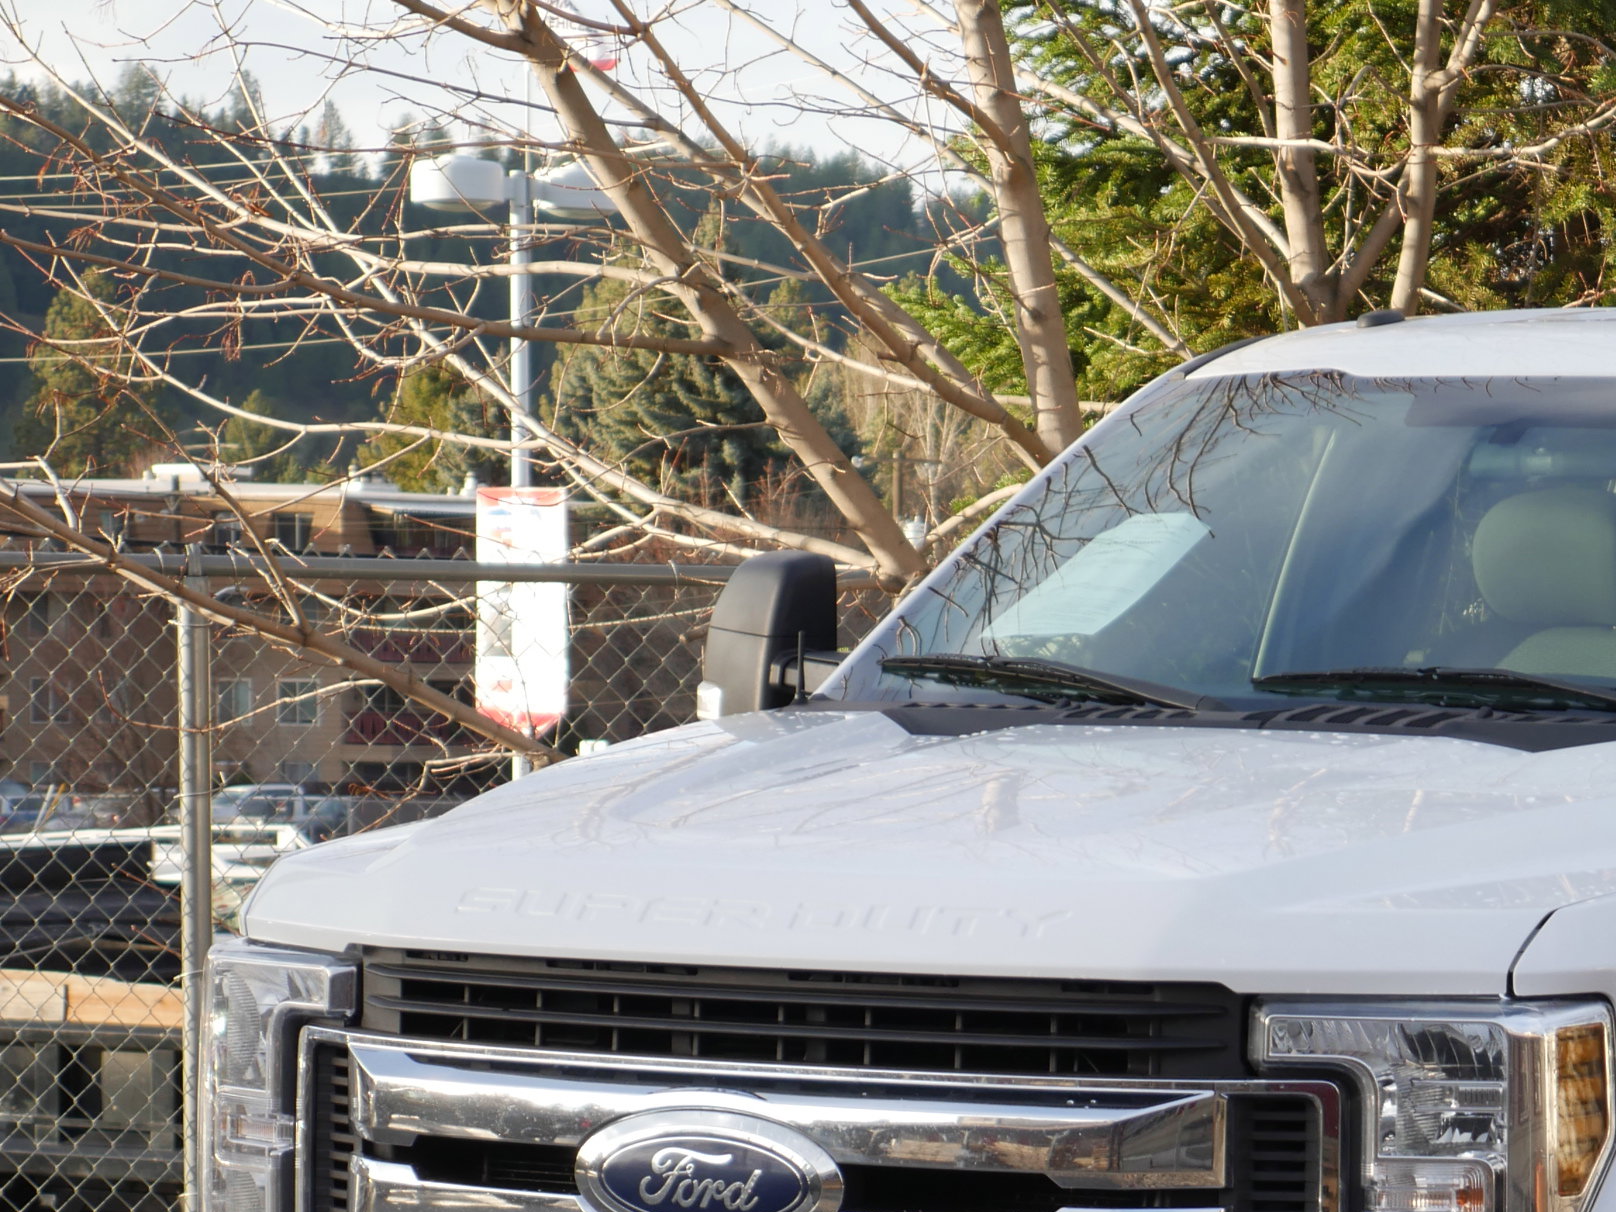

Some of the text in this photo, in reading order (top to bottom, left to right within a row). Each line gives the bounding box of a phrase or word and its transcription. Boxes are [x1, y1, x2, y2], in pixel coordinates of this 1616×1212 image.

[455, 886, 1074, 940] SUPER DUTY
[639, 1146, 762, 1212] Ford
